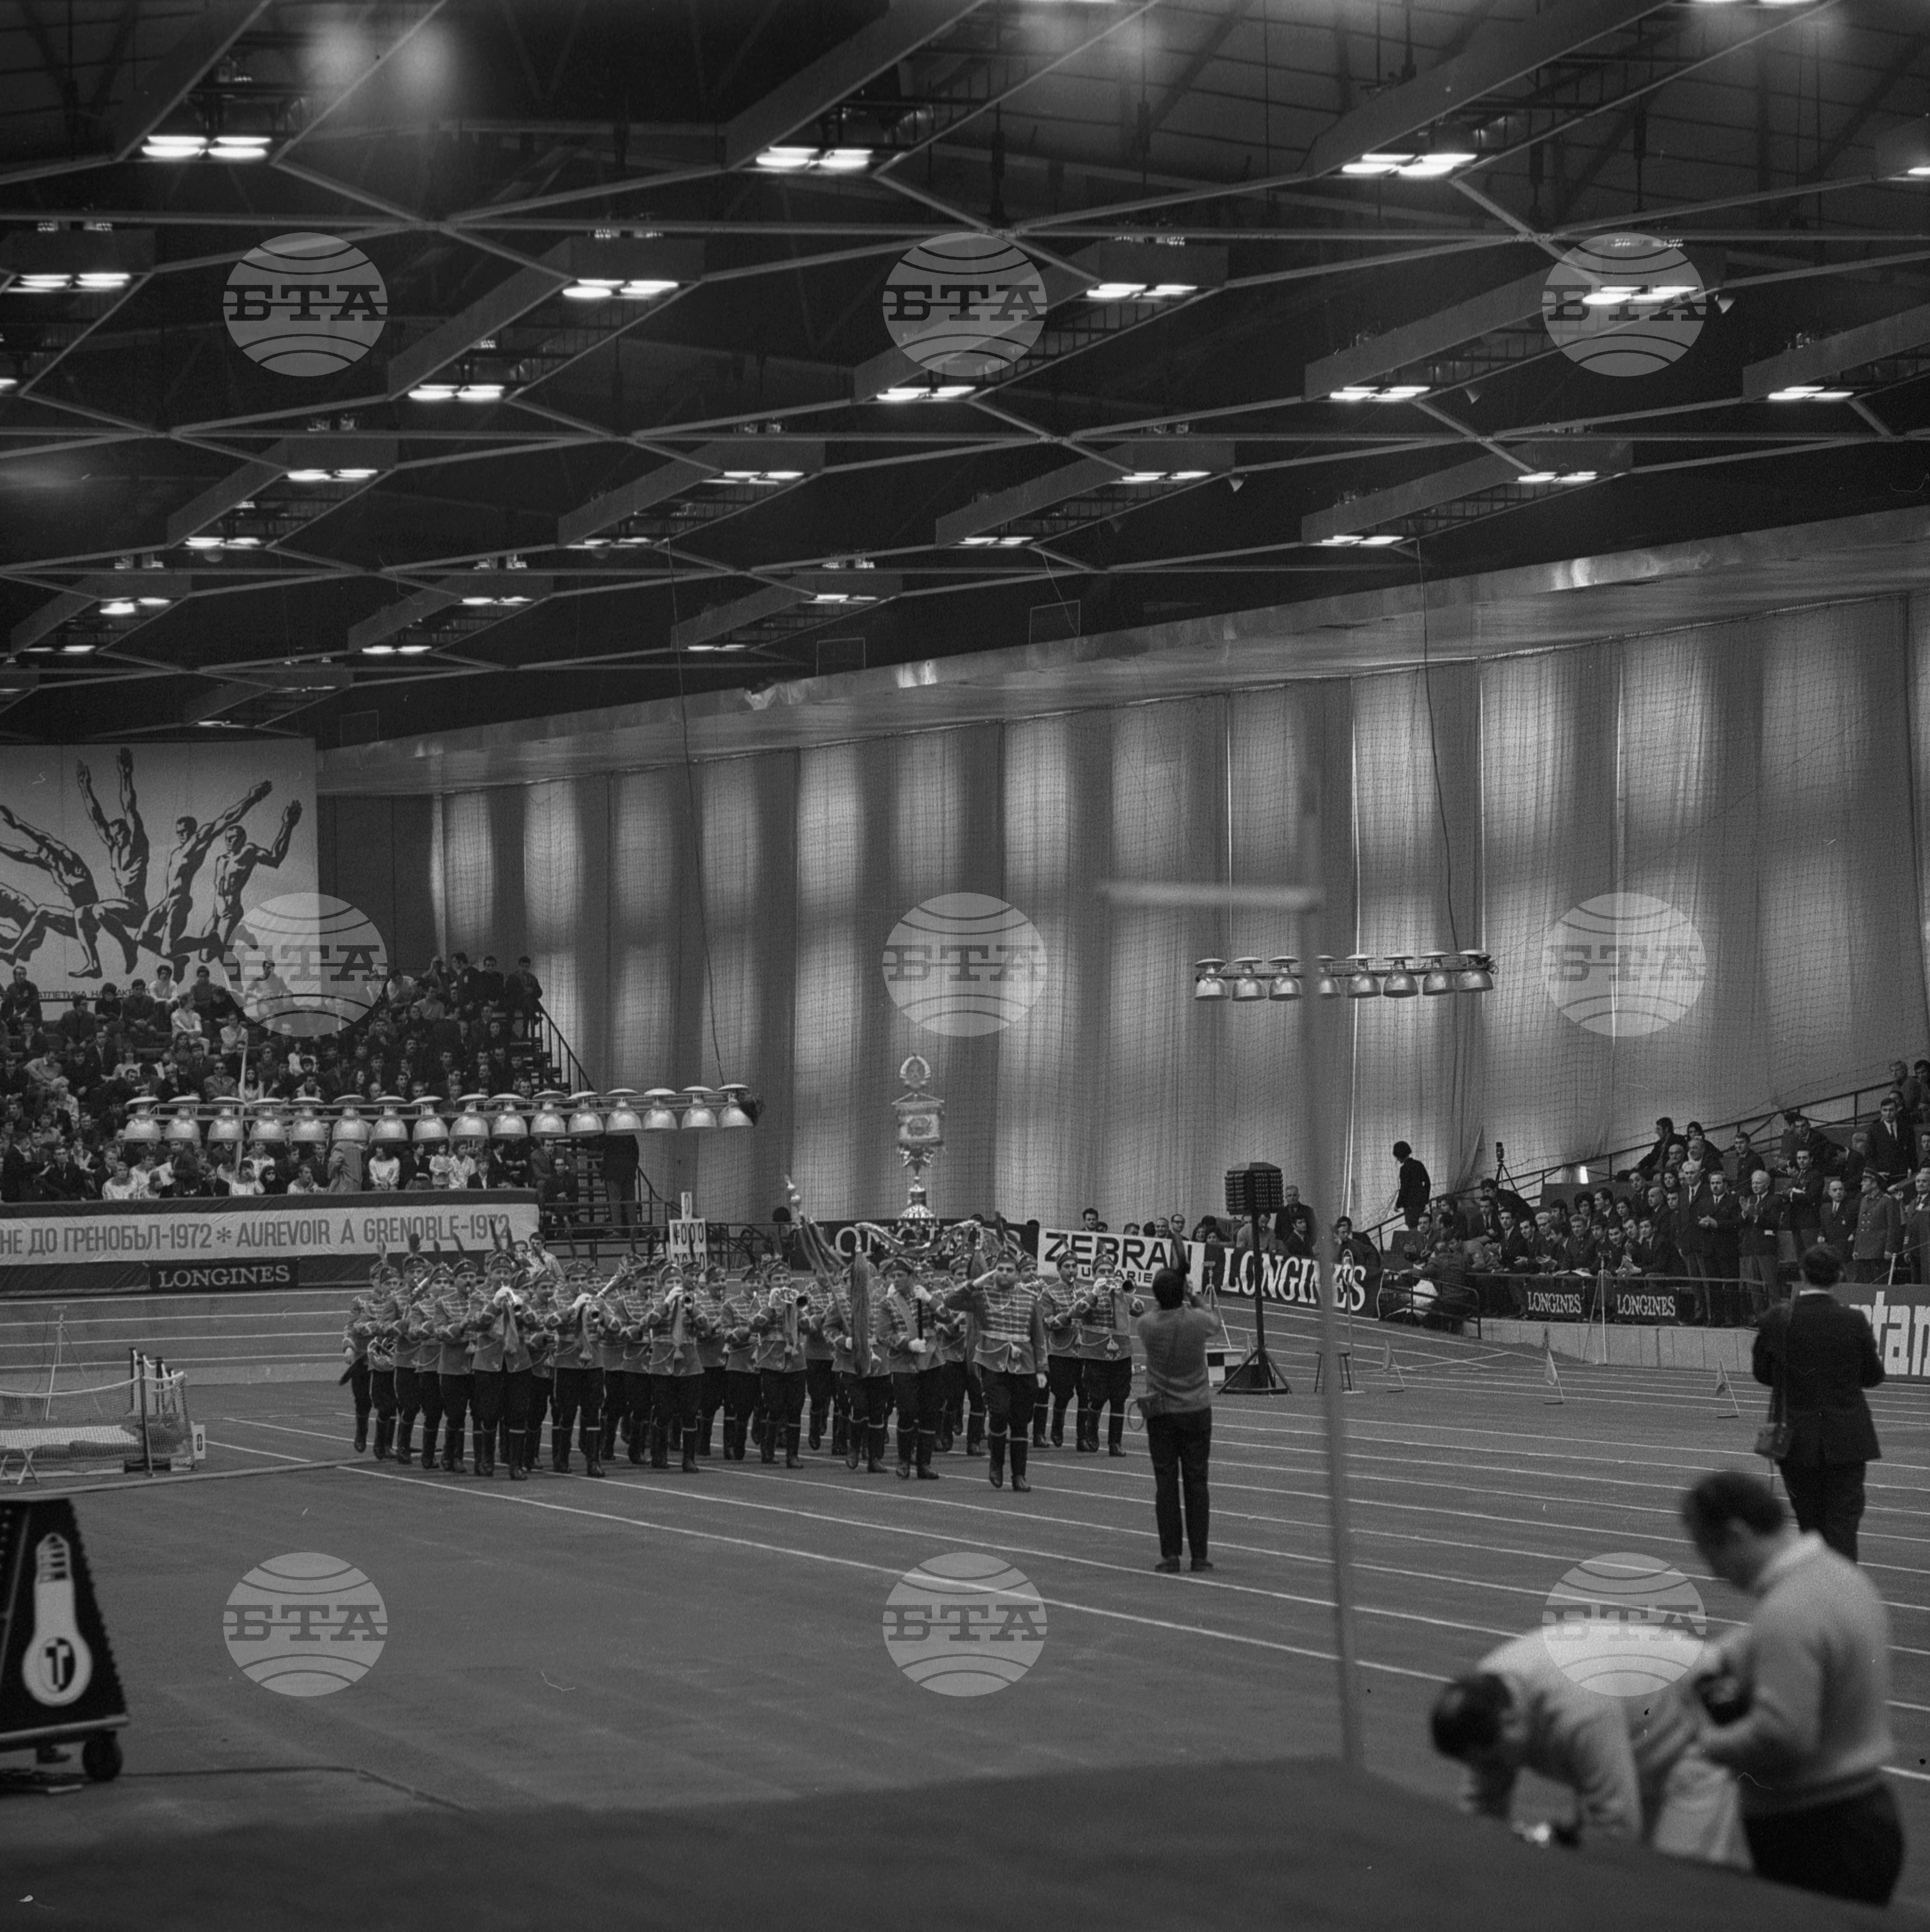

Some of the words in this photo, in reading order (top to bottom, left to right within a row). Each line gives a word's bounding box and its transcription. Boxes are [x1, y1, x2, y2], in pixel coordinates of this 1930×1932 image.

[28, 1228, 57, 1256] ДО
[64, 1223, 213, 1252] ГРЕНОБЪЛ-1972
[236, 1220, 331, 1248] AUREVOIR
[340, 1219, 355, 1245] A
[363, 1214, 510, 1243] GRENOBLE-1972
[158, 1265, 290, 1288] LONGINES
[1528, 1292, 1582, 1313] LONGINES
[1617, 1294, 1675, 1316] LONGINES
